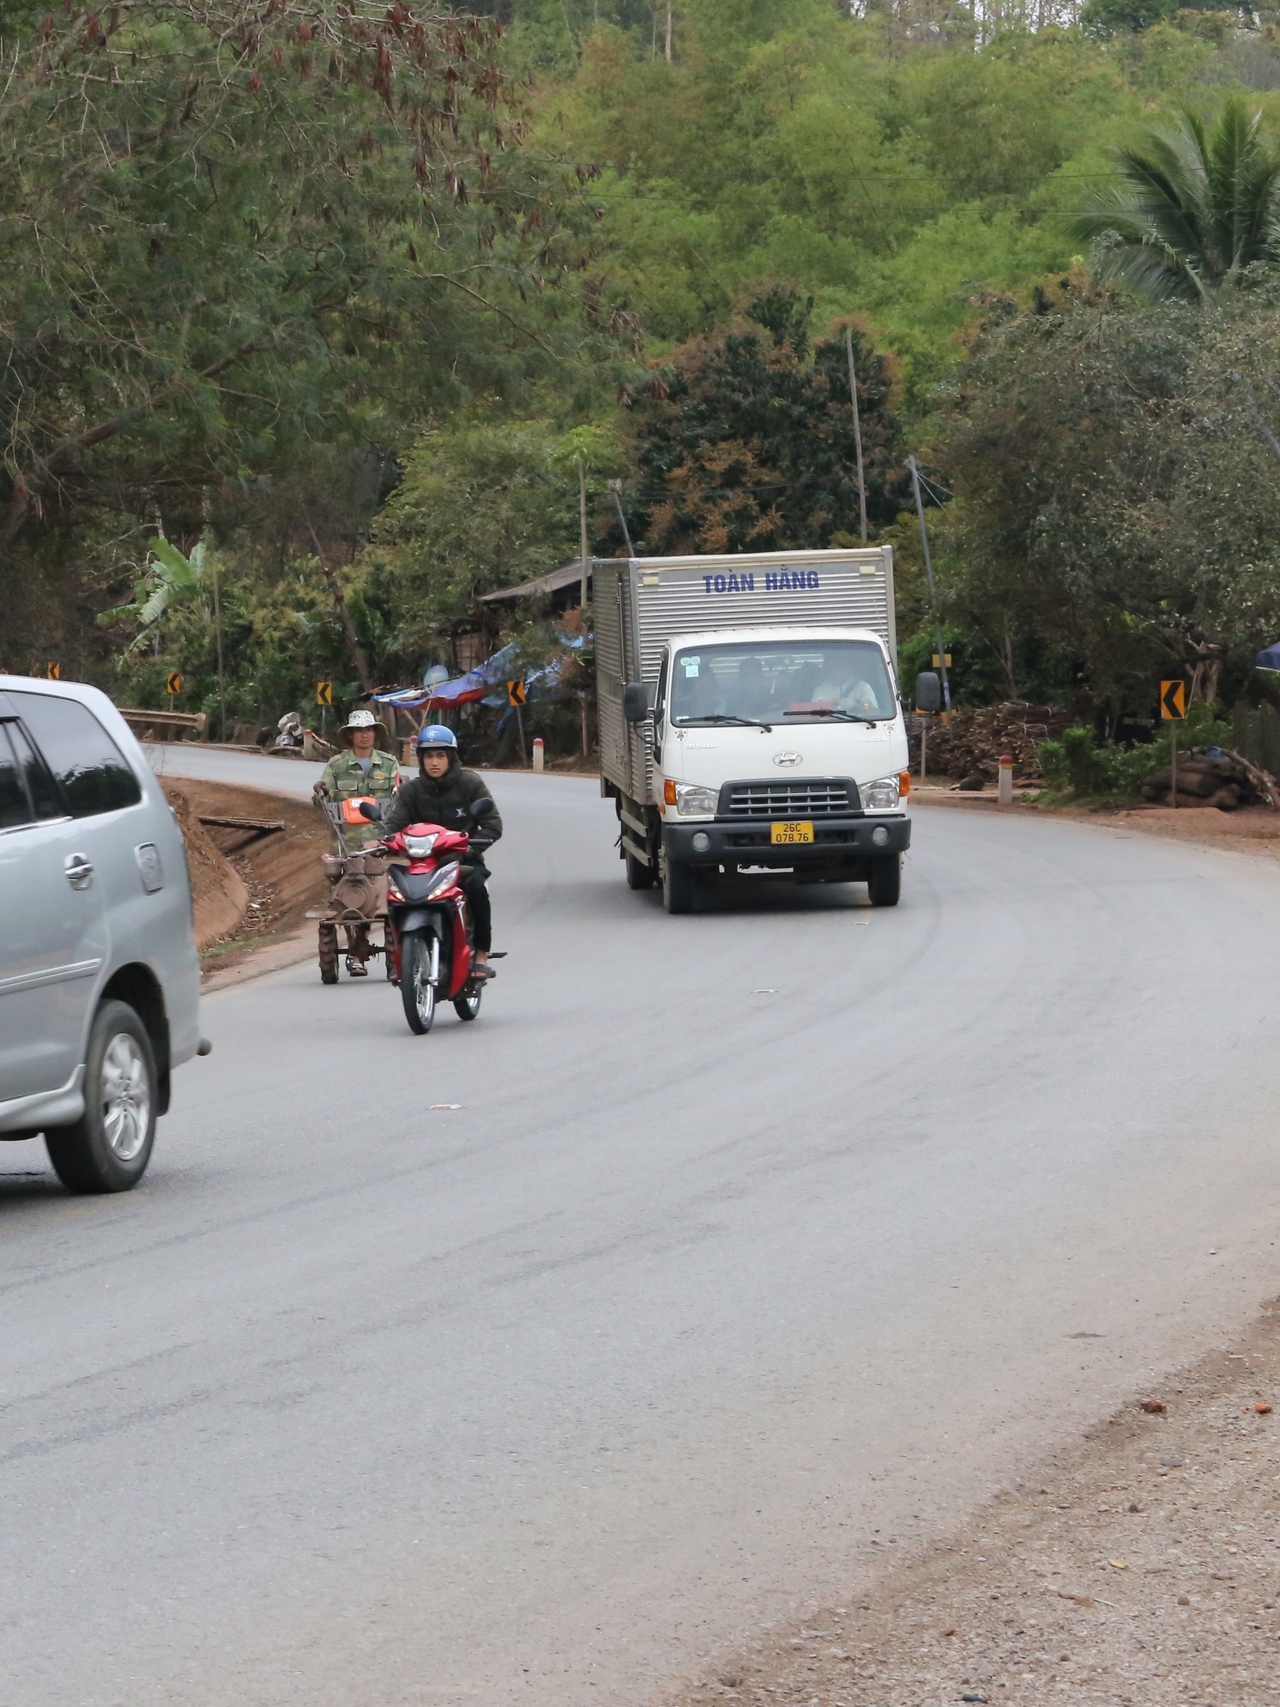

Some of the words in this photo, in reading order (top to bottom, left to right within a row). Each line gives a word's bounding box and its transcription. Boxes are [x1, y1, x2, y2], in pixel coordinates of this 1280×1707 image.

[702, 568, 755, 594] TOÀN
[783, 823, 802, 833] 26C
[776, 833, 809, 843] 078.76
